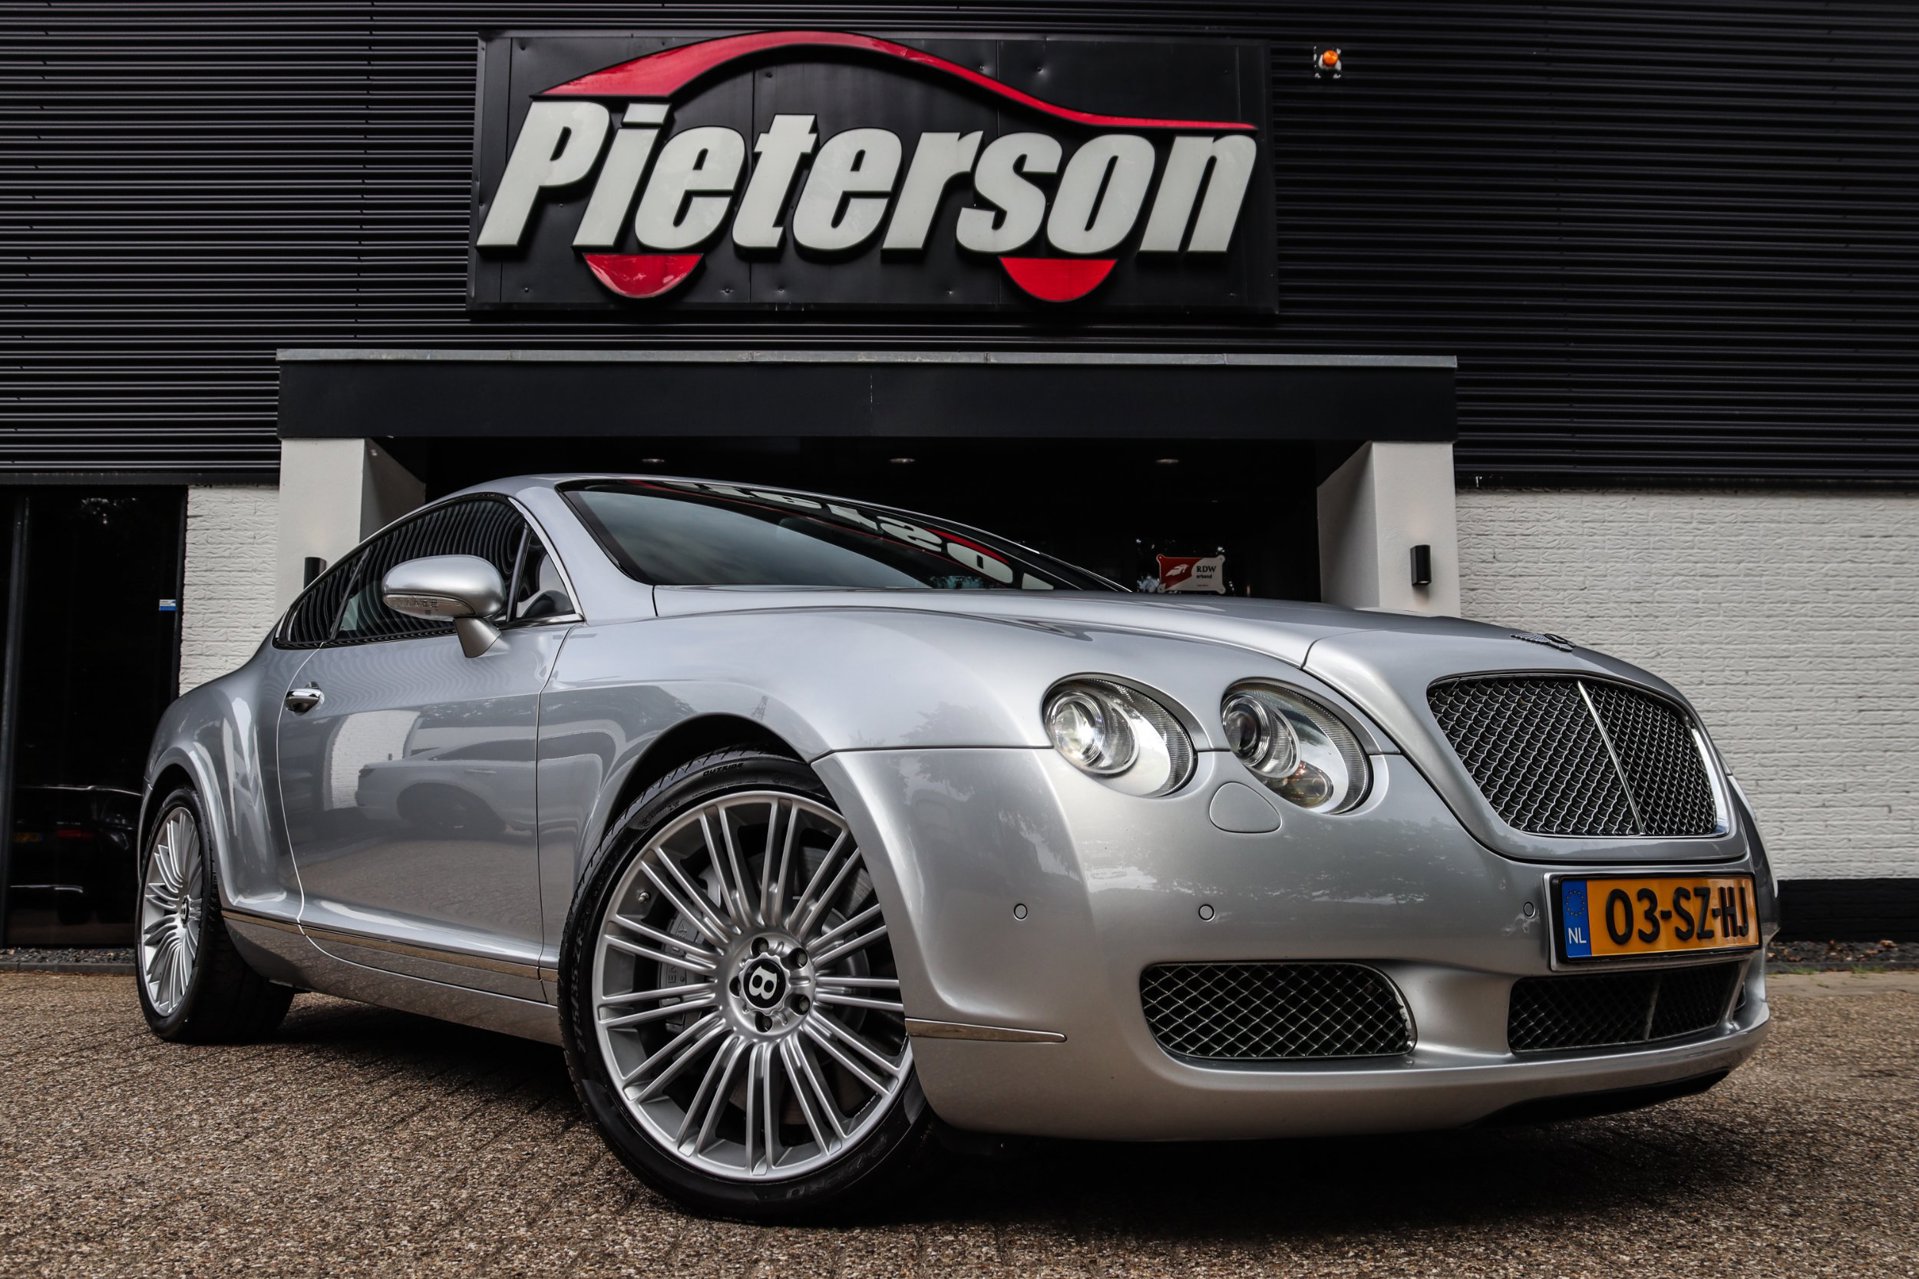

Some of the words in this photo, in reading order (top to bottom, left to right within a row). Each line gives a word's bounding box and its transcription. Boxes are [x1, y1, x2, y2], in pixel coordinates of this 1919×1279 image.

[476, 101, 1257, 253] Pieterson
[1196, 565, 1217, 573] RDW
[1605, 886, 1749, 945] 03-SZ-HJ
[1568, 927, 1587, 945] NL
